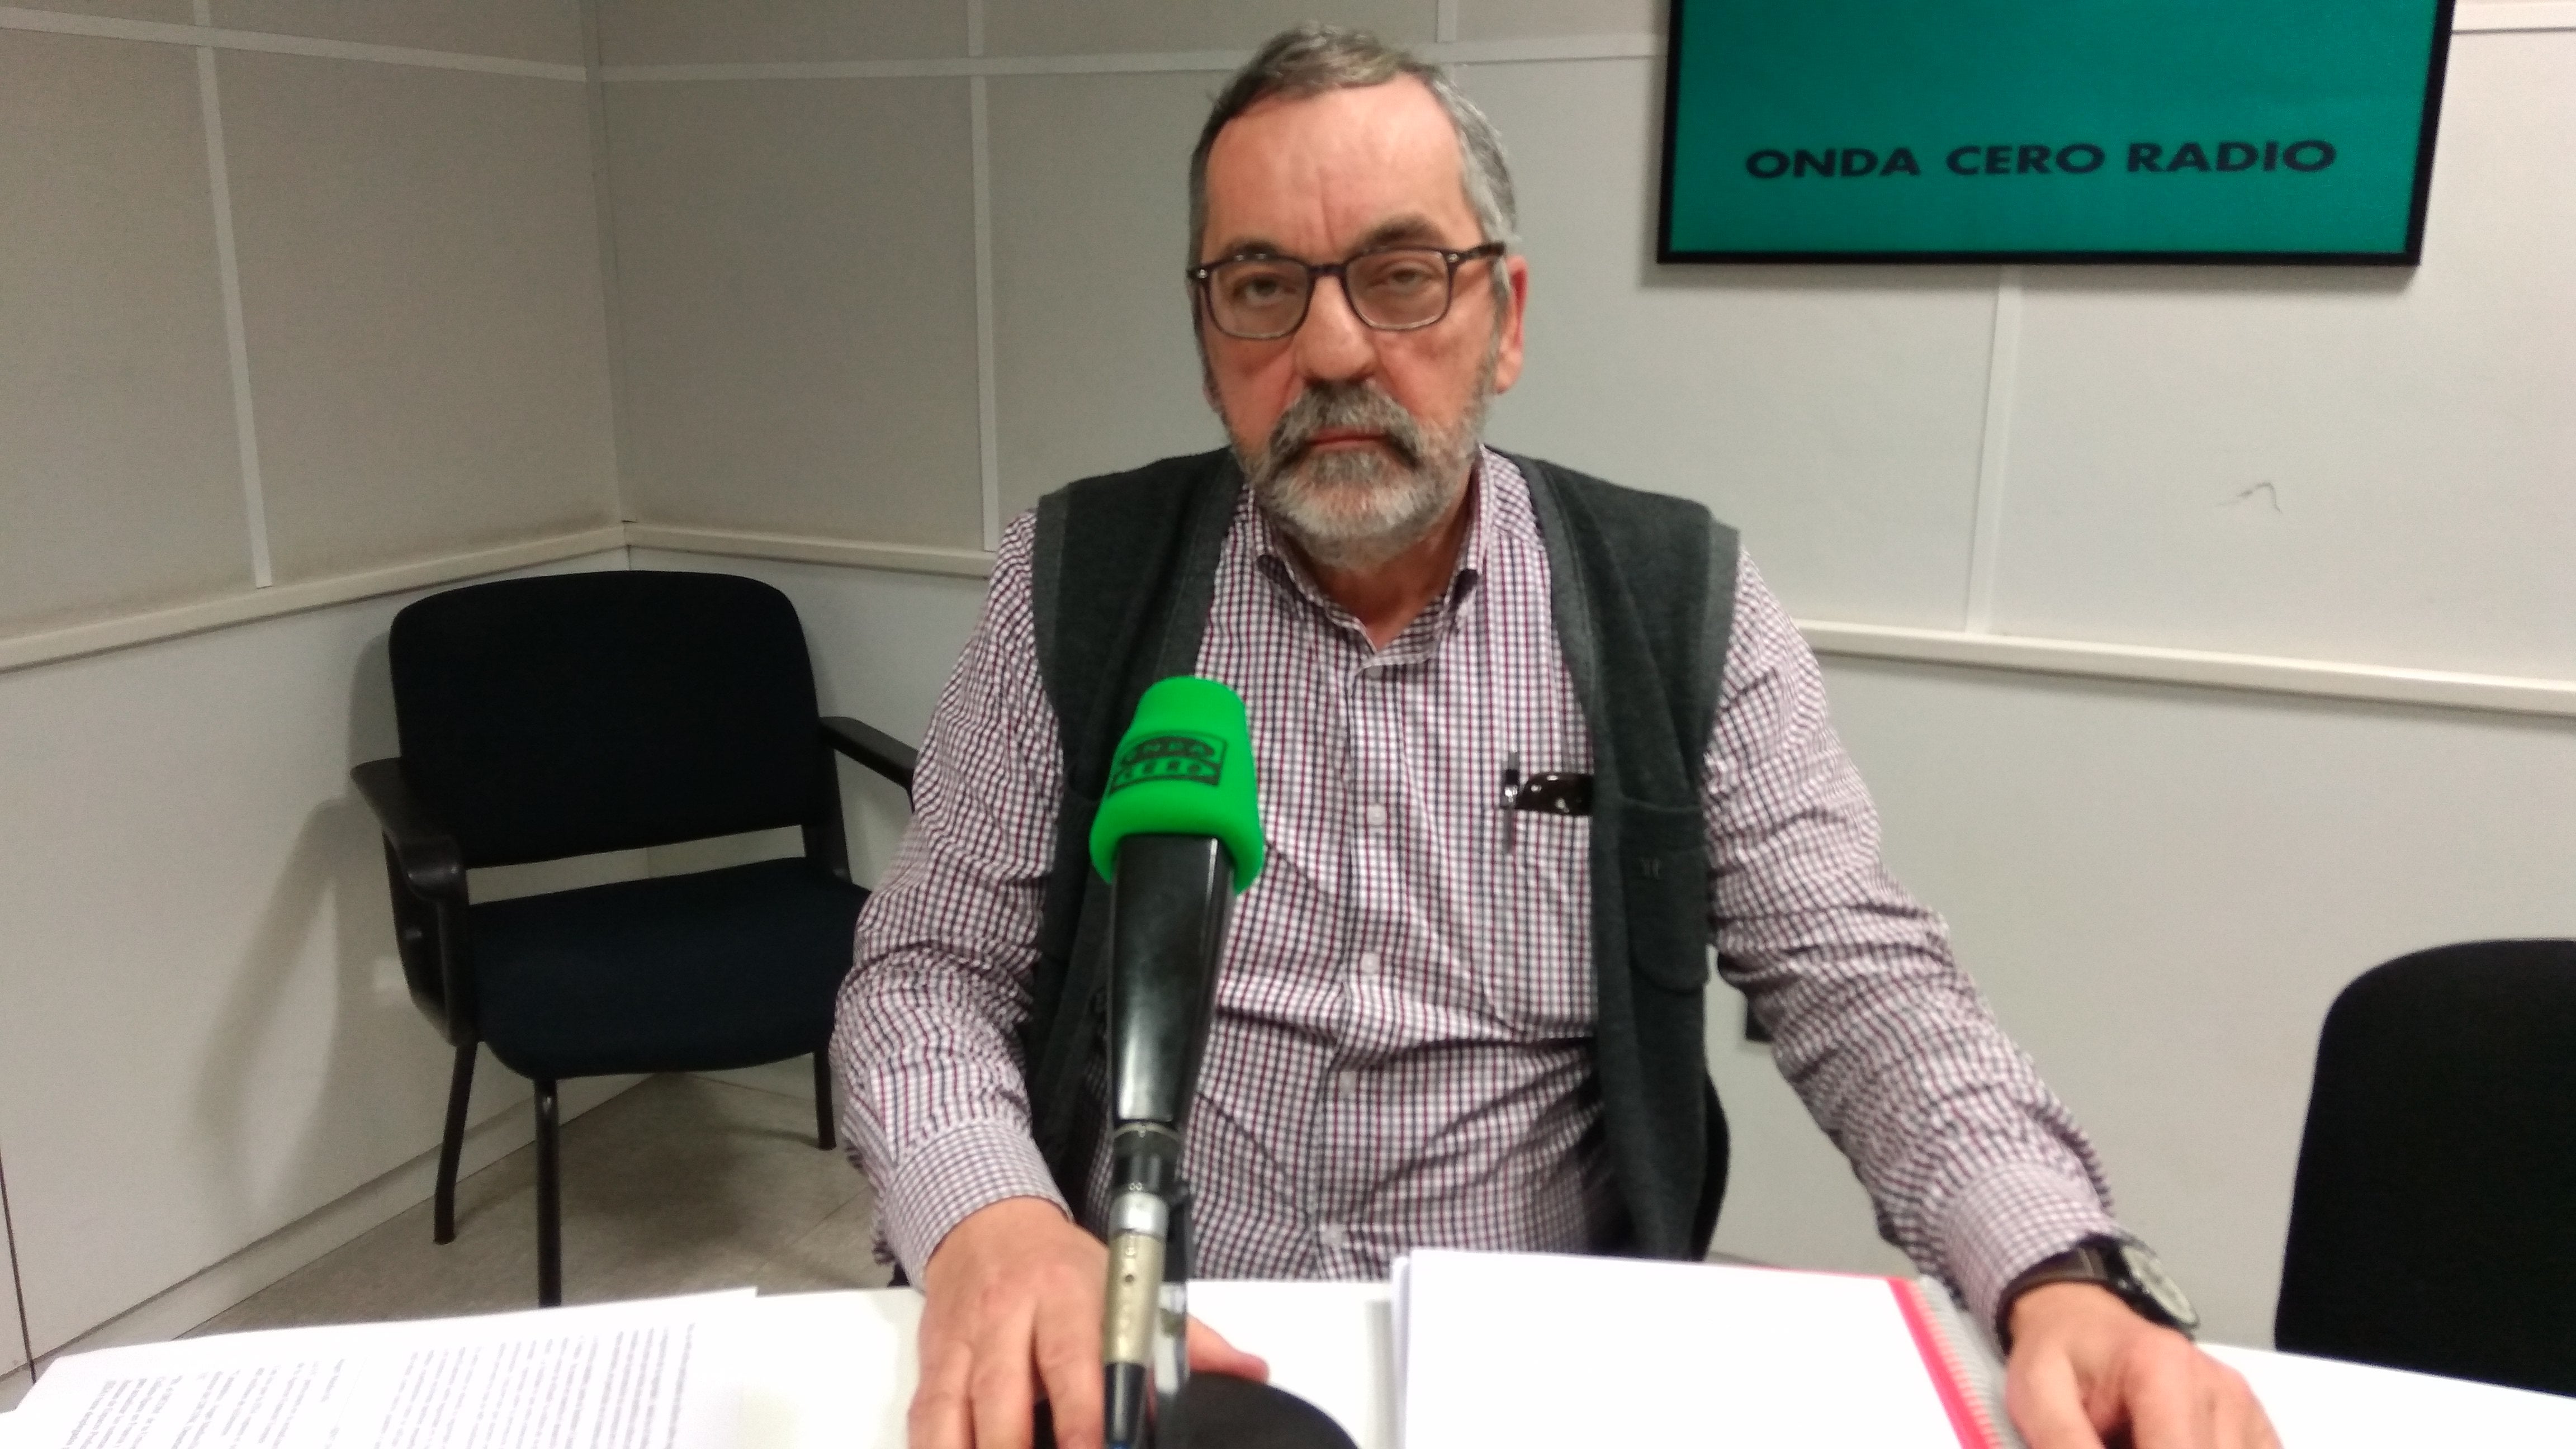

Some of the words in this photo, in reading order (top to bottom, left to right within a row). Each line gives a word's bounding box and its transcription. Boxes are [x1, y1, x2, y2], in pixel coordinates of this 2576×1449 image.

[1744, 147, 1921, 181] ONDA
[1946, 143, 2106, 177] CERO
[2127, 140, 2337, 173] RADIO
